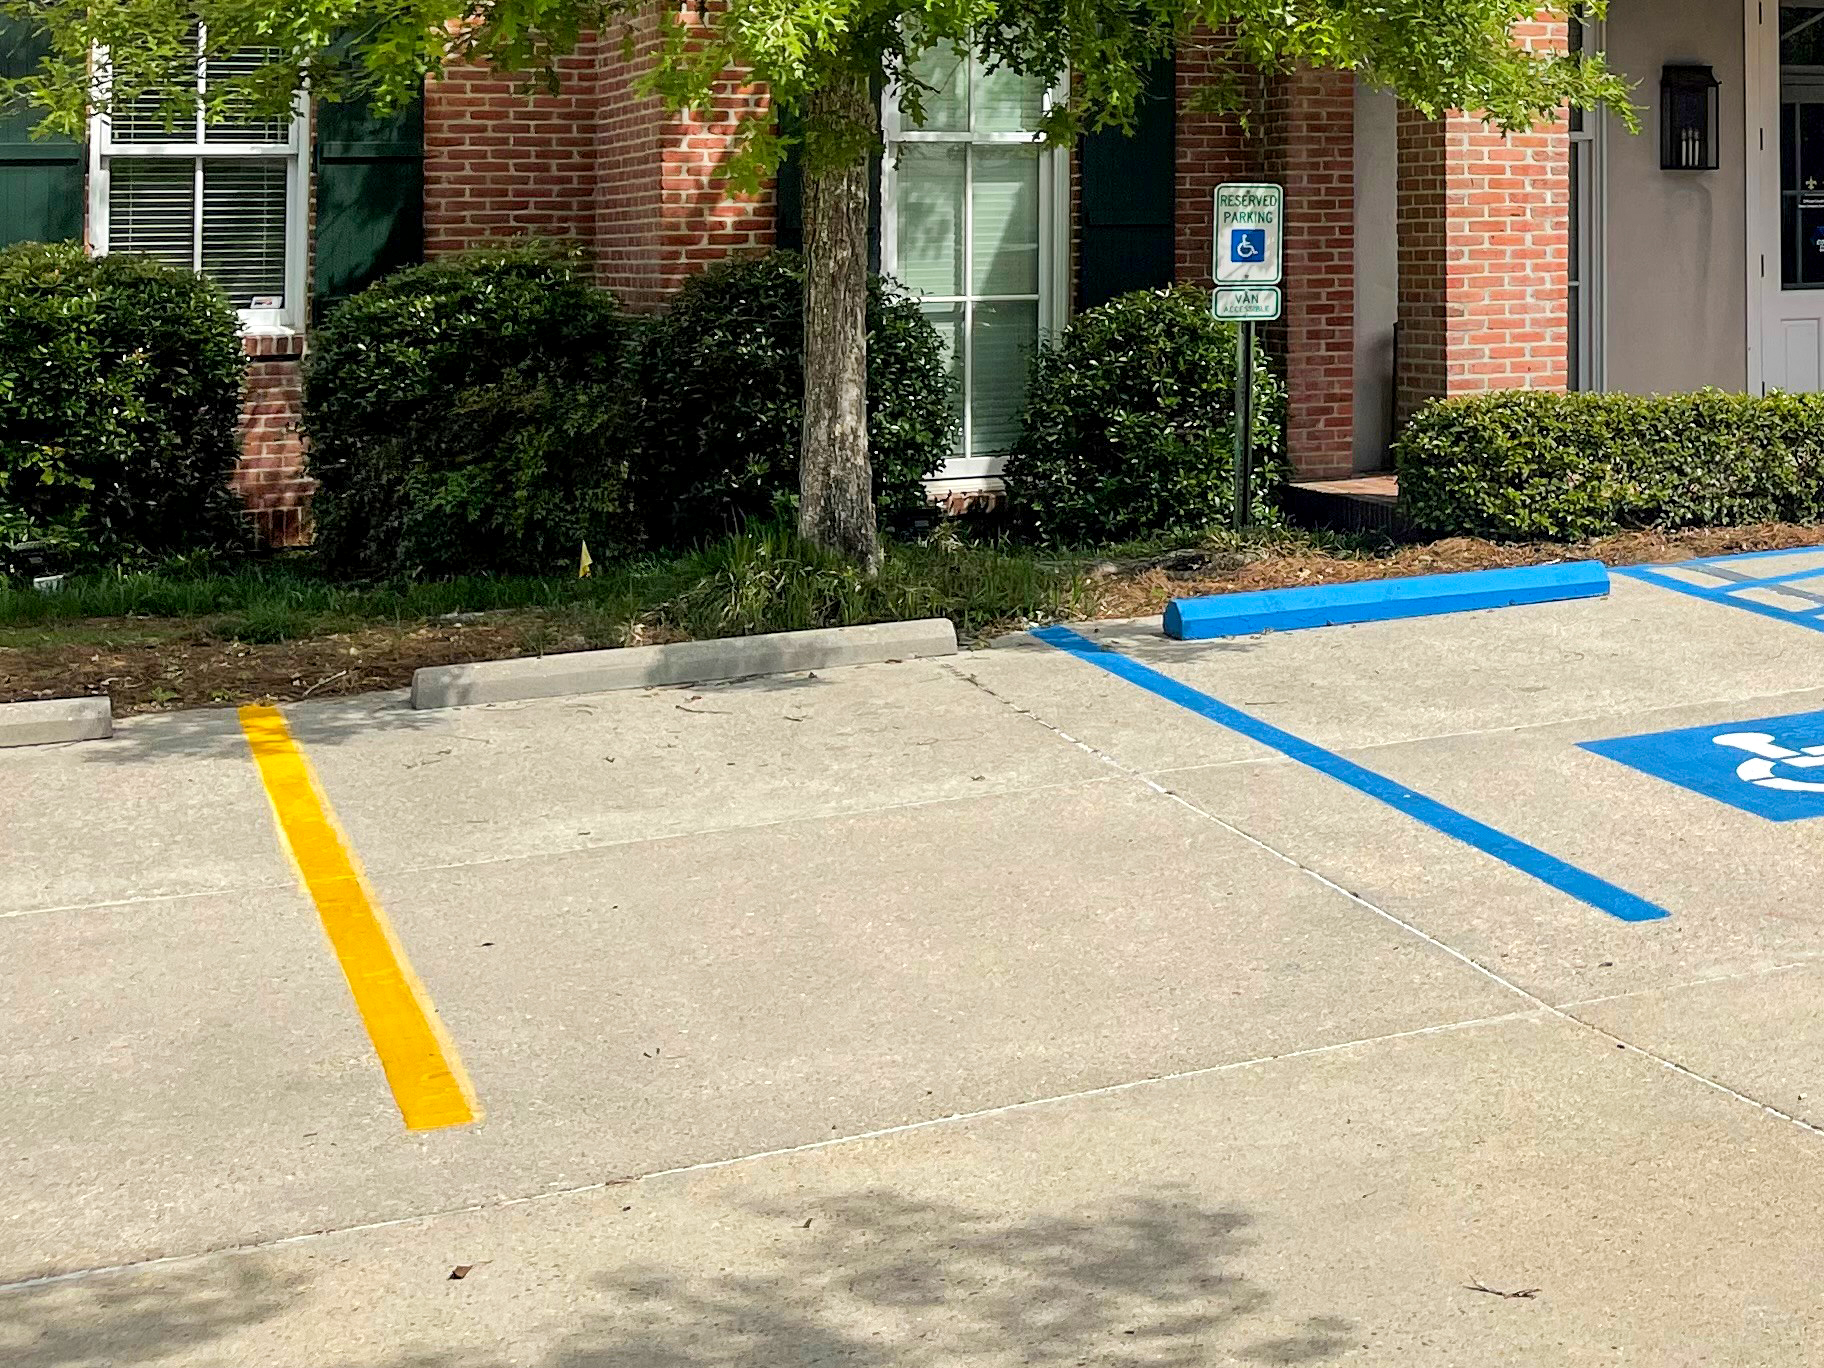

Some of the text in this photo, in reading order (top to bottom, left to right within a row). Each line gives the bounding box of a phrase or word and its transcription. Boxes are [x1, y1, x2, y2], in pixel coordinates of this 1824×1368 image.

[1220, 195, 1277, 207] RESERVED
[1223, 211, 1273, 224] PARKING
[1235, 293, 1259, 304] VAN
[1223, 304, 1270, 313] ACCESSIBLE
